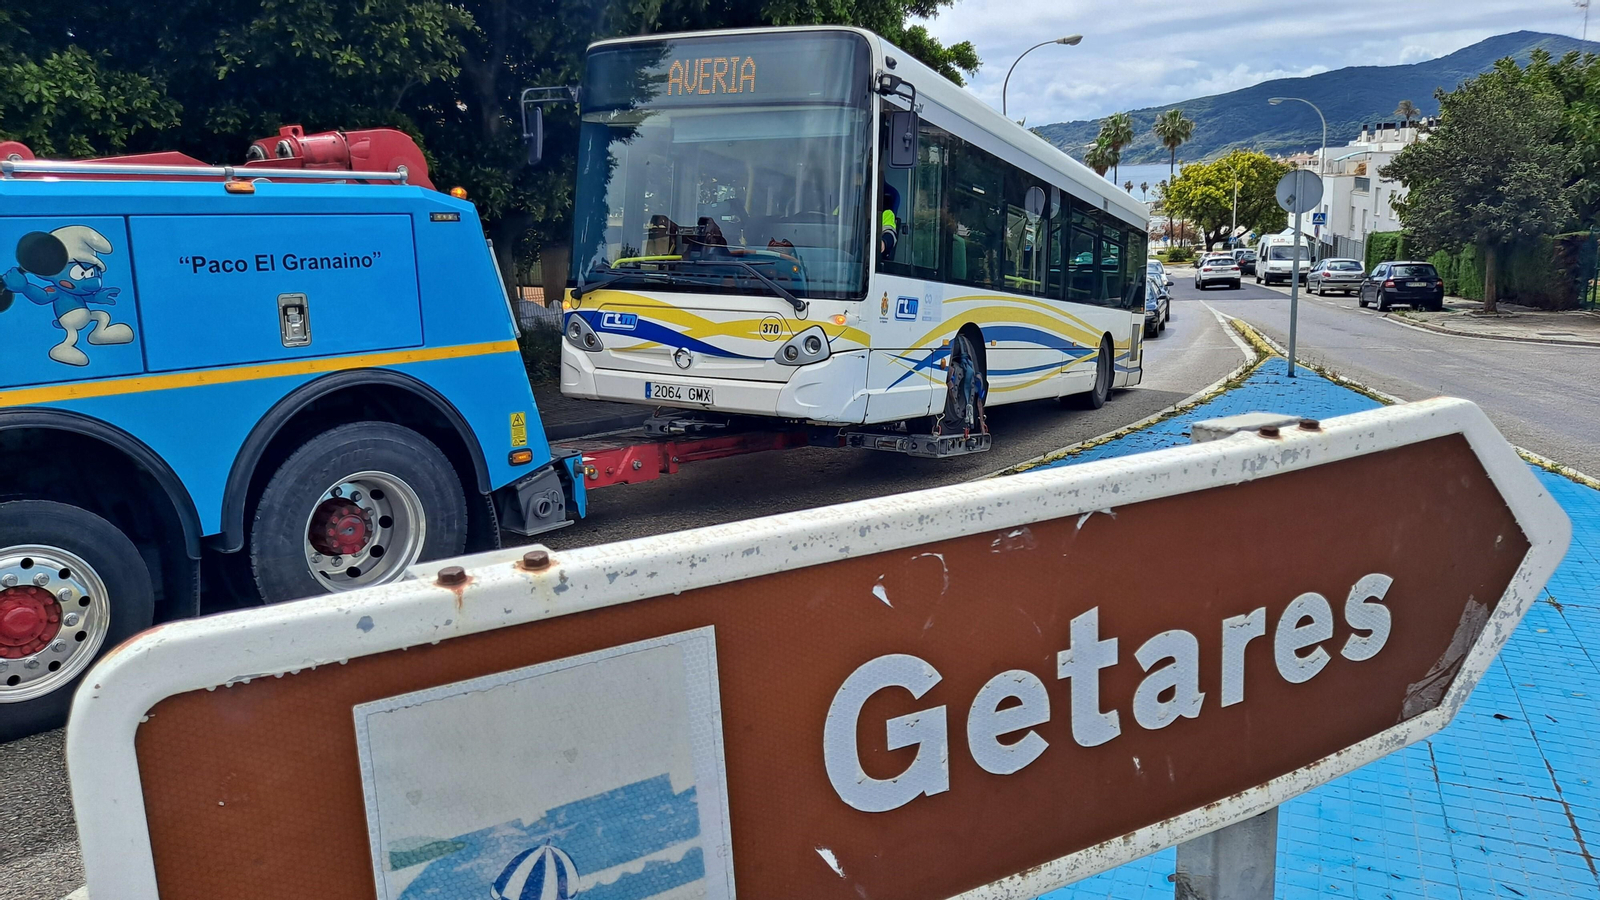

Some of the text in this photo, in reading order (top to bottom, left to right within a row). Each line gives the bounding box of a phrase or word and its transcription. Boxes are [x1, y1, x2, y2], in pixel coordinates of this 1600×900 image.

[667, 56, 756, 96] AVERIA
[254, 254, 275, 272] El
[763, 323, 779, 334] 370
[654, 384, 710, 402] 2064 GMX
[823, 573, 1394, 813] Getares
